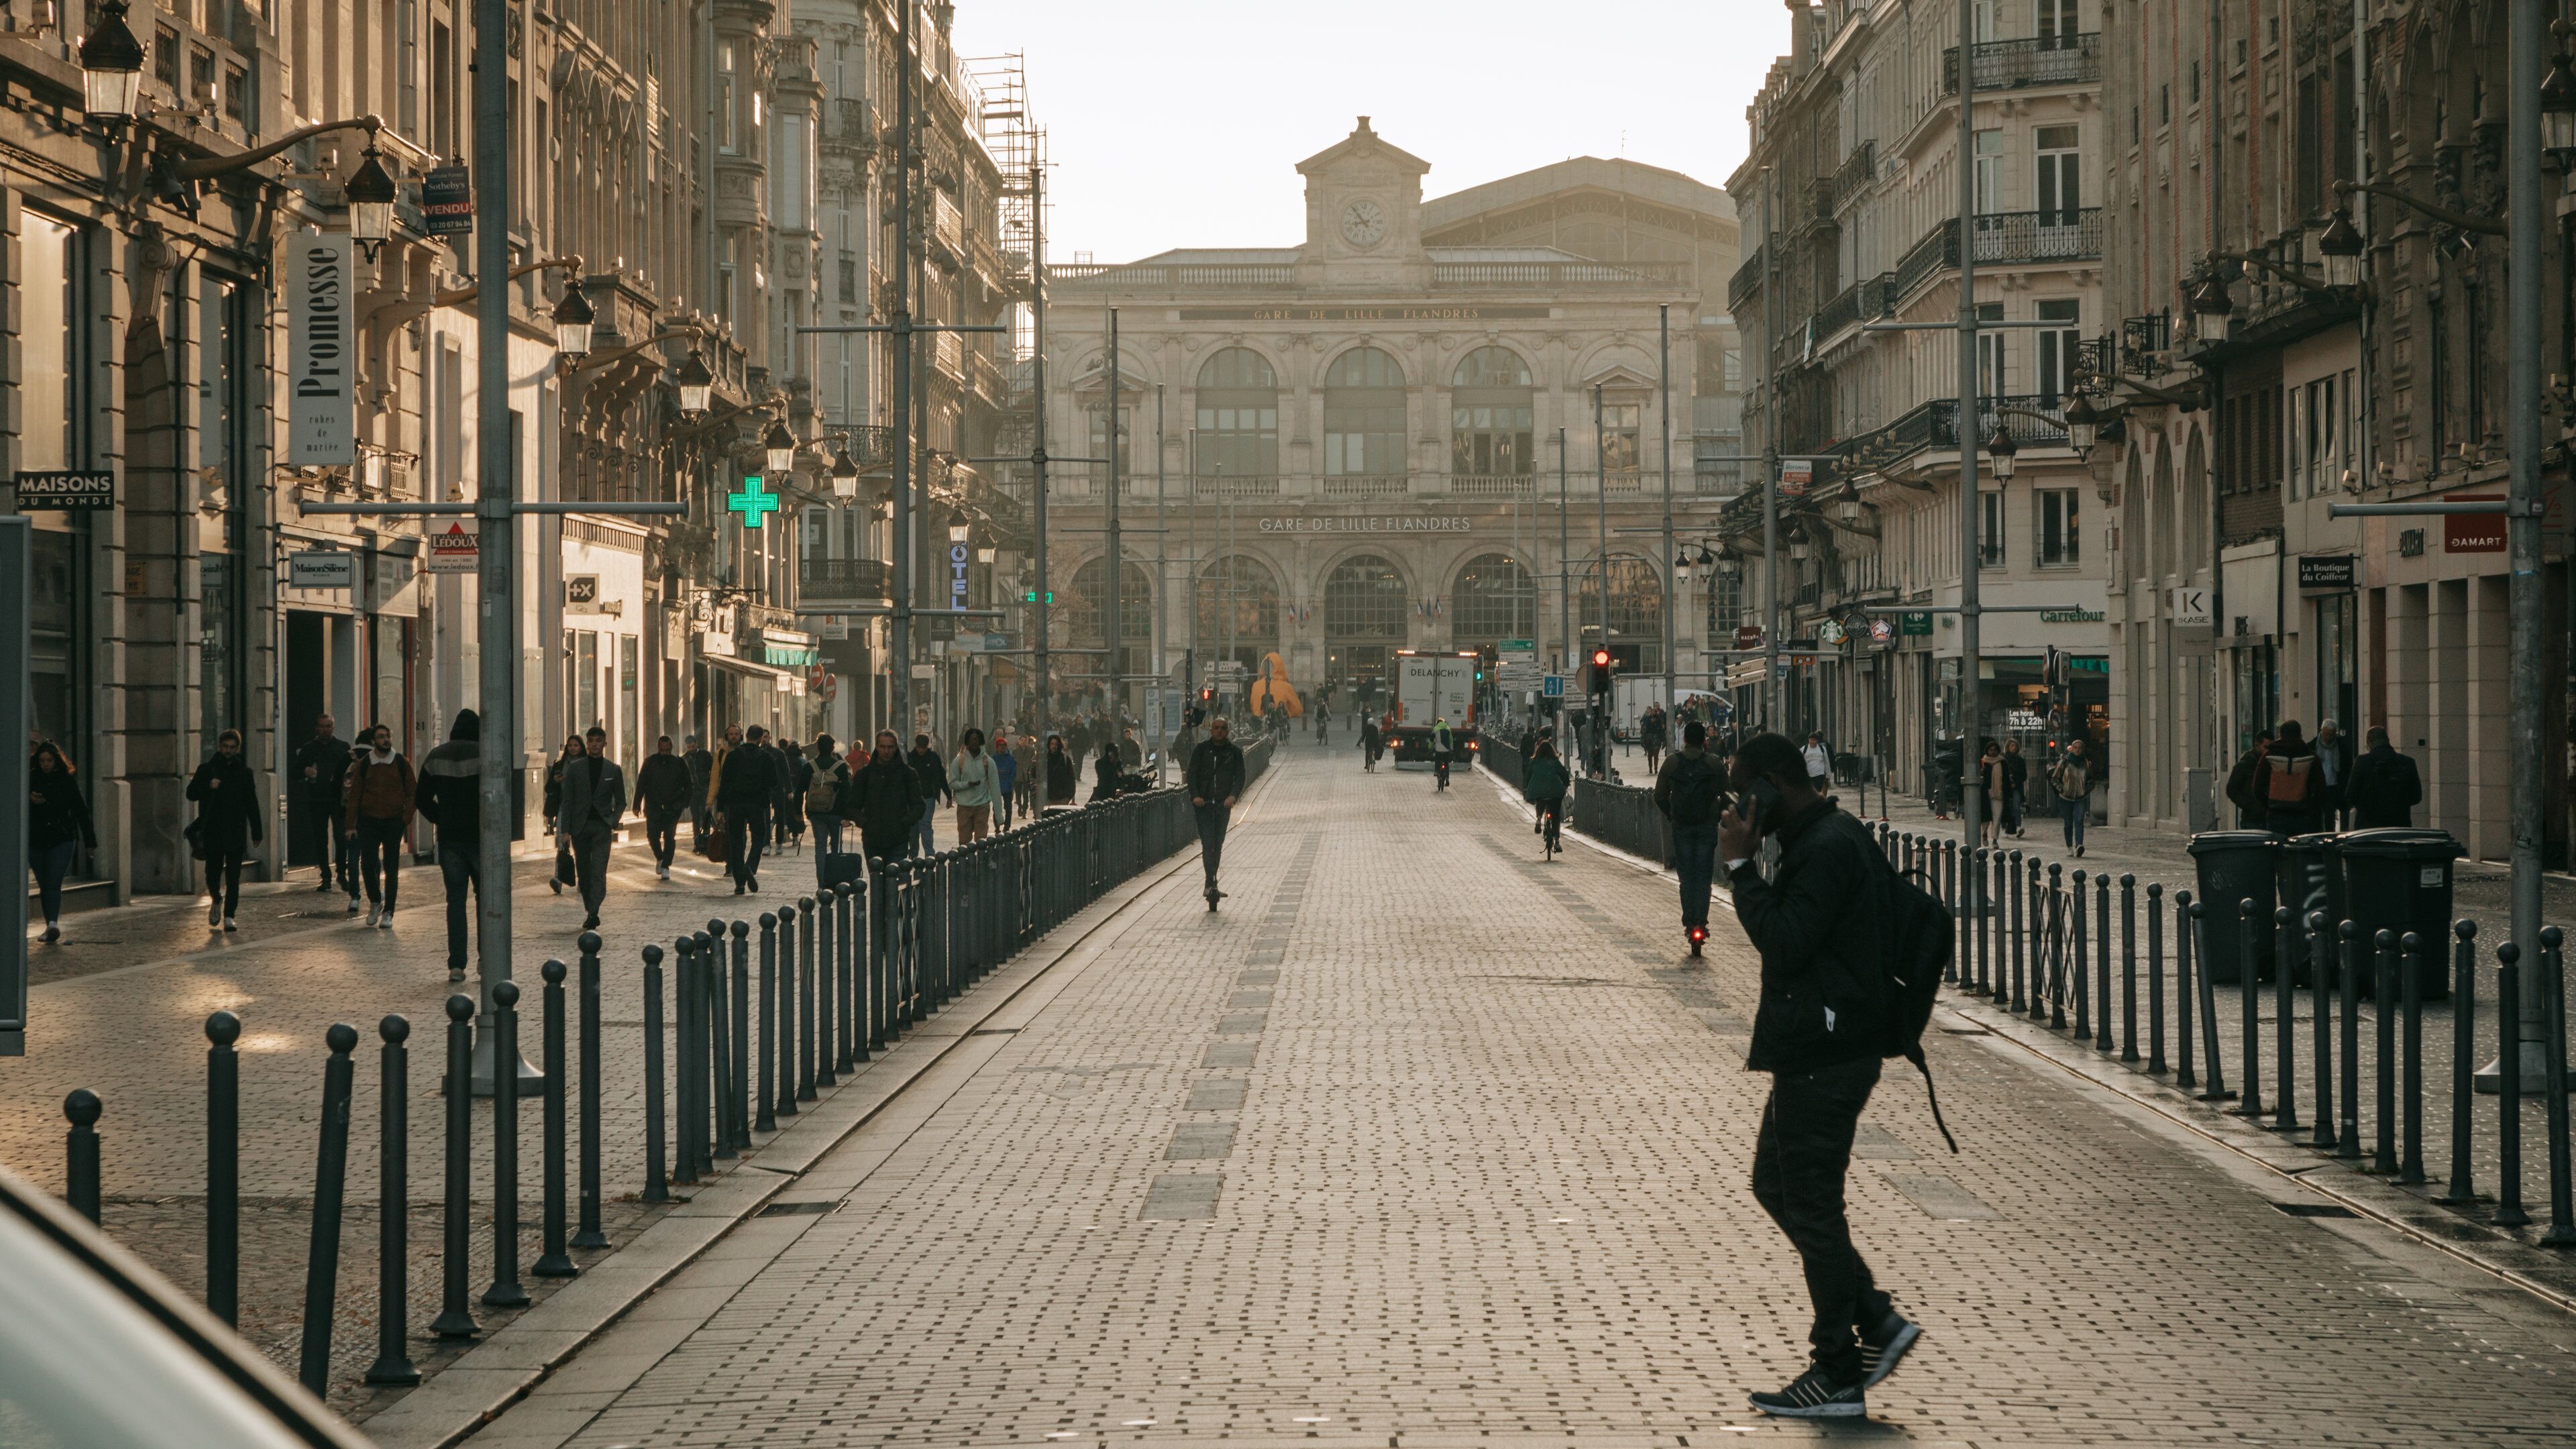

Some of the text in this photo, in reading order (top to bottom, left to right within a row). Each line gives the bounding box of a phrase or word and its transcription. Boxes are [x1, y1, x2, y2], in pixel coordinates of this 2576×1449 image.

[429, 181, 465, 190] Sotheby's
[427, 203, 468, 215] VENDU
[1254, 309, 1479, 320] GARE DE LILLE FLANDRES
[297, 248, 339, 398] Promesse
[309, 415, 335, 424] robes
[317, 428, 327, 437] de
[307, 442, 338, 451] mariée
[19, 476, 111, 492] MAISONS
[52, 497, 110, 505] MONDE
[1259, 517, 1470, 531] GARE DE LILLE FLANDRES
[432, 535, 478, 547] LEDOUX
[2451, 537, 2502, 547] DAMART
[2314, 564, 2350, 574] Boutique
[951, 541, 967, 612] OTEL
[2302, 572, 2348, 581] du Coiffeur
[2040, 608, 2105, 623] Carrefour
[1411, 669, 1459, 678] DELANCHY
[2009, 716, 2043, 725] 7h à 22h
